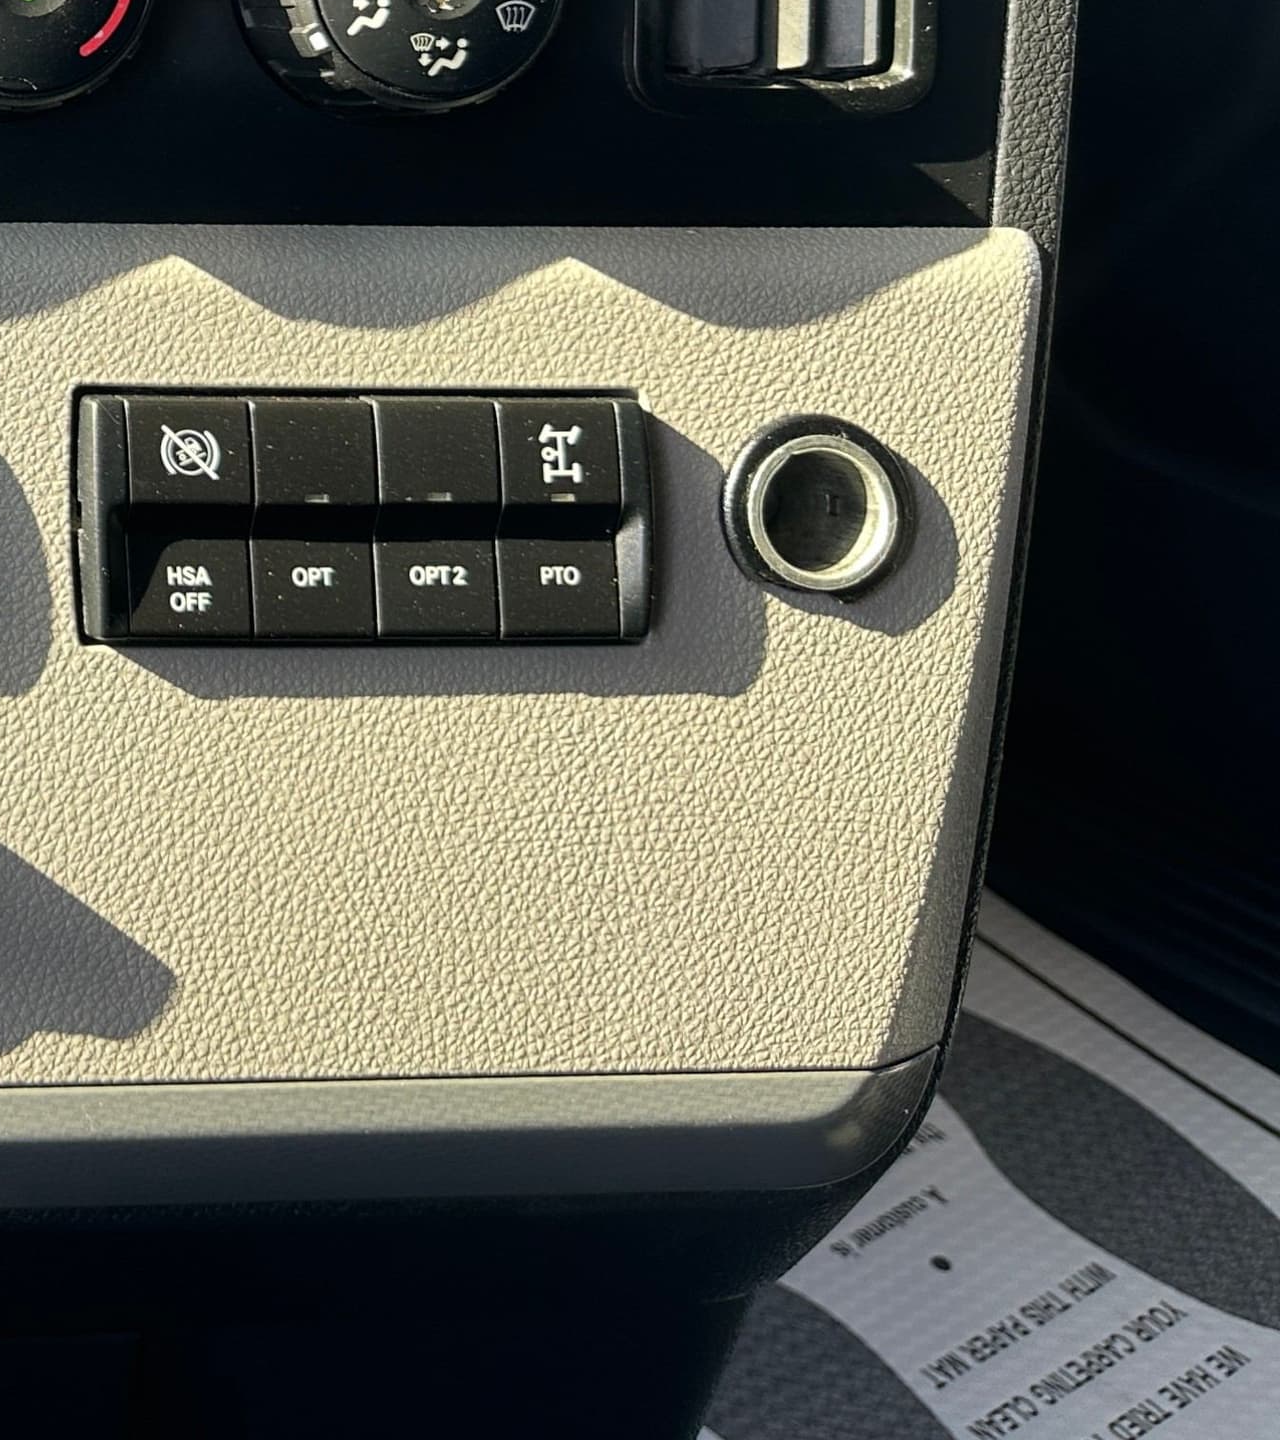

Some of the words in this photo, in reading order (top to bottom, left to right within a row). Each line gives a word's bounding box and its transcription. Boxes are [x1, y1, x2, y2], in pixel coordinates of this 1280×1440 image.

[166, 565, 213, 587] HSA
[291, 567, 335, 588] OPT
[539, 565, 581, 586] PTO
[169, 591, 213, 613] OFF
[1058, 1261, 1118, 1303] WITH
[1019, 1291, 1073, 1327] THIS
[1122, 1300, 1189, 1343] YOUR
[958, 1315, 1031, 1364] PAPER
[919, 1351, 972, 1391] MAT
[1029, 1332, 1137, 1406] CARPETING
[1205, 1344, 1252, 1378] WE
[1158, 1365, 1221, 1410] HAVE
[966, 1395, 1039, 1440] CLEAN
[1107, 1398, 1173, 1440] TRIED
